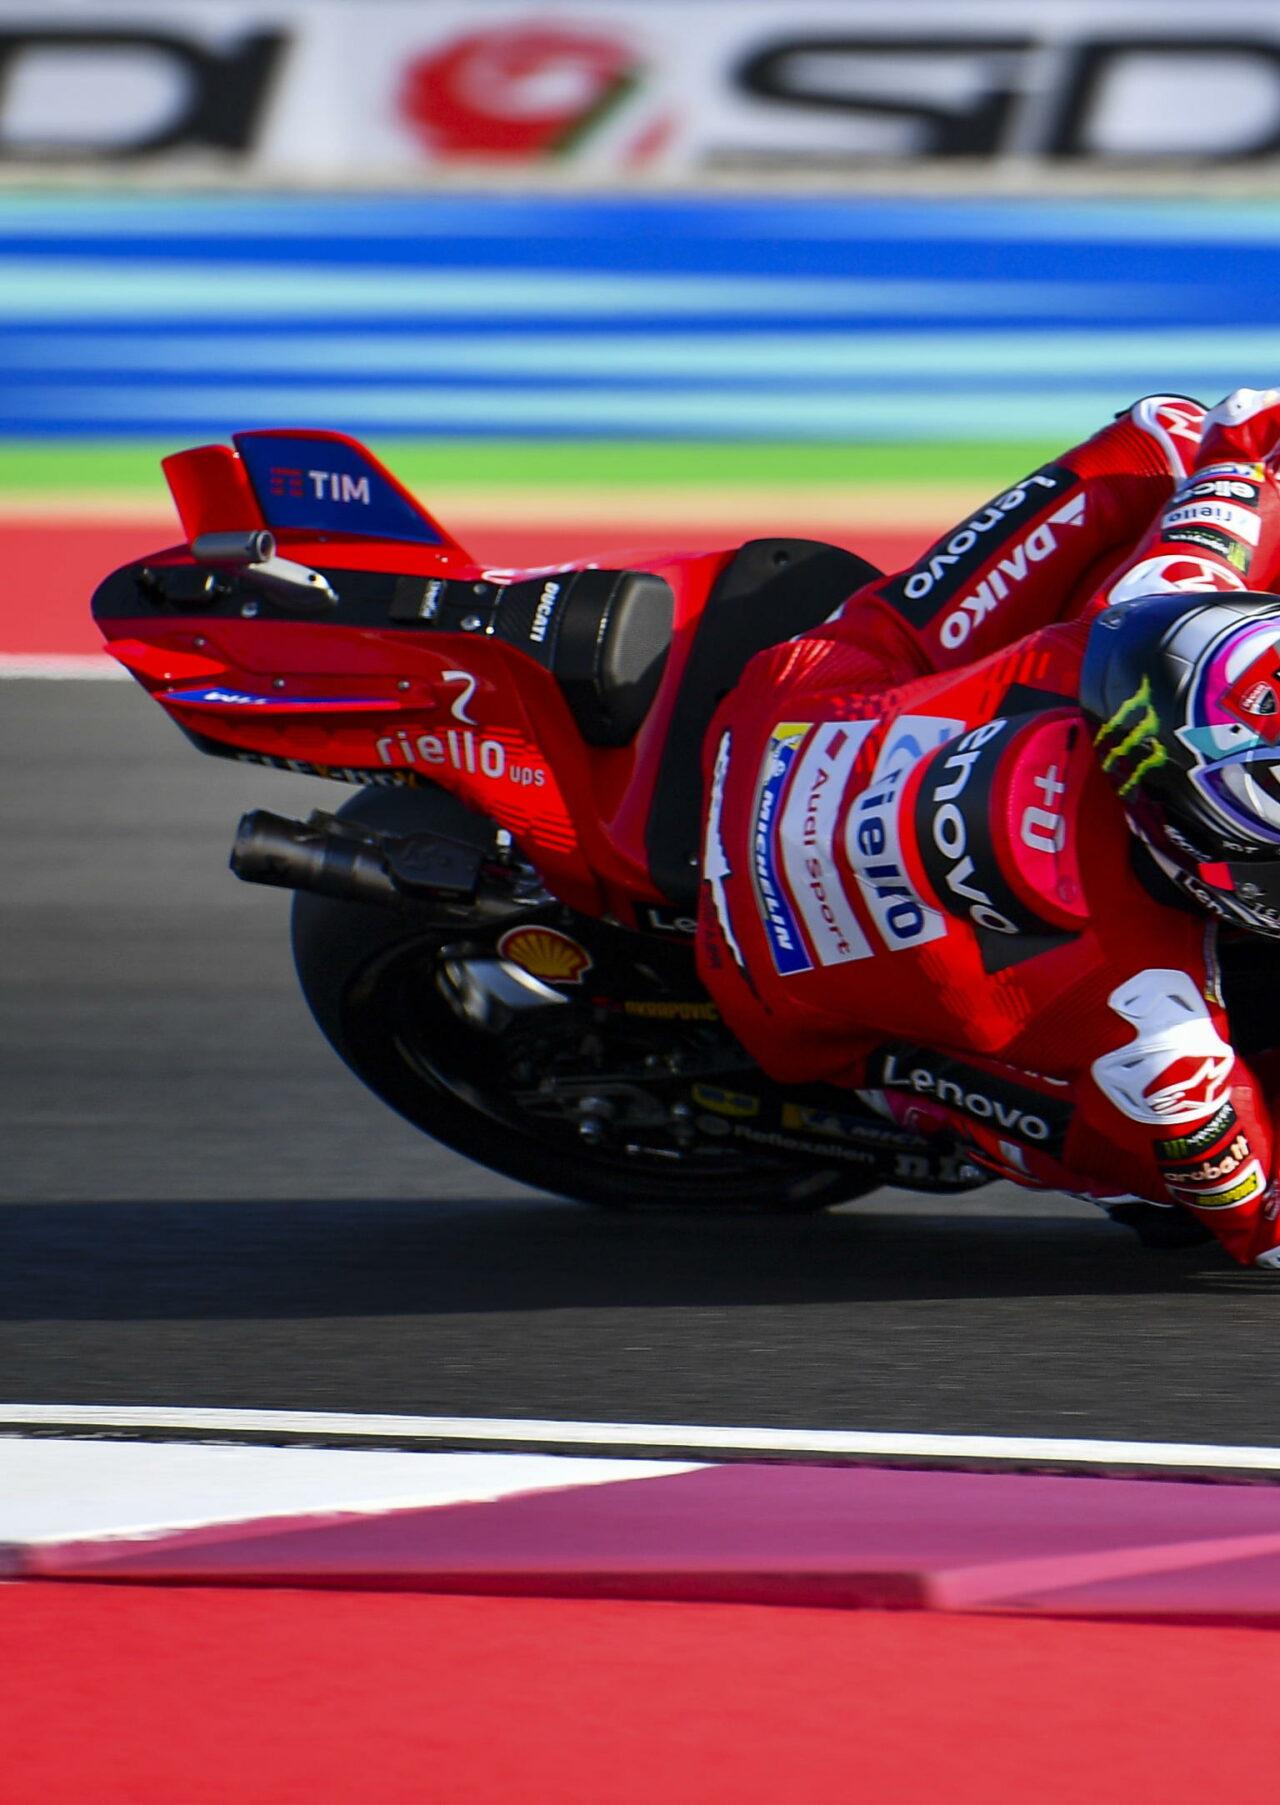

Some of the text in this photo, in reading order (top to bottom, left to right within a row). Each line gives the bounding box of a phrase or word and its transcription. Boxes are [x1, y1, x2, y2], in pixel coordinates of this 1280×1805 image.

[308, 469, 370, 505] TIM
[904, 475, 1057, 600] Lenovo
[1168, 507, 1232, 522] riello
[529, 581, 560, 643] DUCATI
[940, 524, 1058, 650] DAIKO
[376, 730, 545, 787] riello ups
[755, 791, 794, 951] MICHELIN
[803, 768, 852, 956] Audi Sport
[858, 768, 925, 940] riello
[933, 719, 1020, 934] enovo
[883, 1055, 1050, 1141] Lenovo
